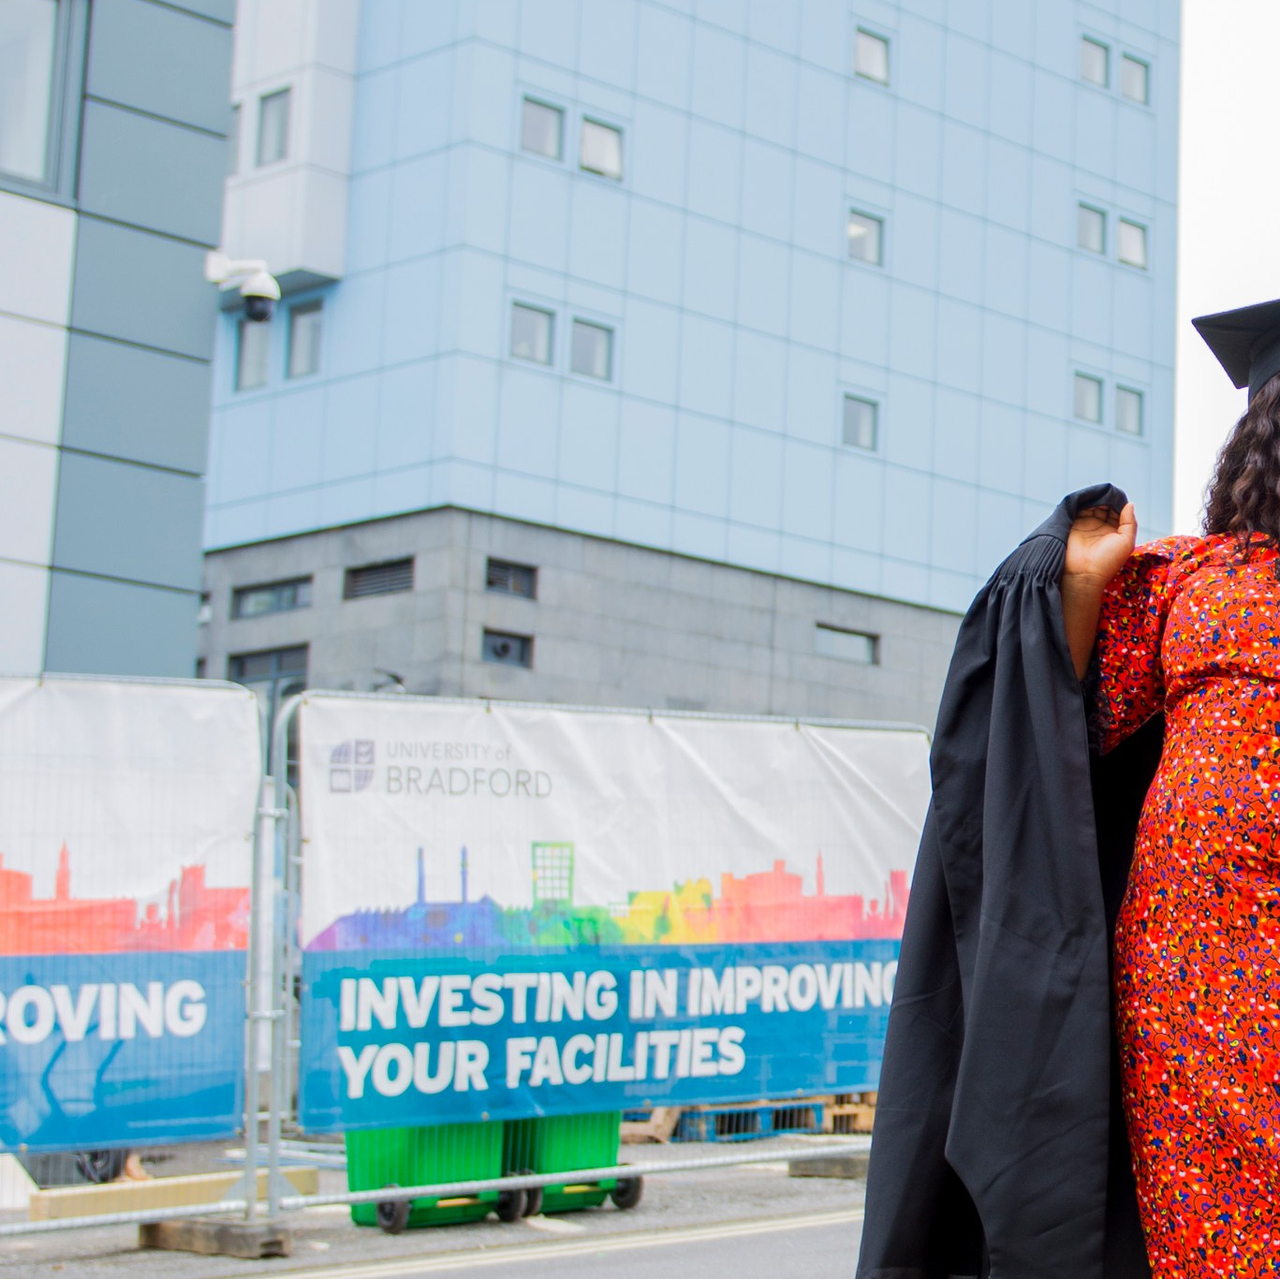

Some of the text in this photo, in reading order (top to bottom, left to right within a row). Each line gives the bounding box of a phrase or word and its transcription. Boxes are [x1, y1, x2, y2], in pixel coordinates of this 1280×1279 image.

[386, 740, 512, 763] UNIVERSITY of
[386, 765, 553, 799] BRADFORD
[0, 979, 208, 1045] OVING
[339, 969, 619, 1032] INVESTING
[629, 968, 679, 1020] IN
[338, 1025, 746, 1100] YOUR FACILITIES
